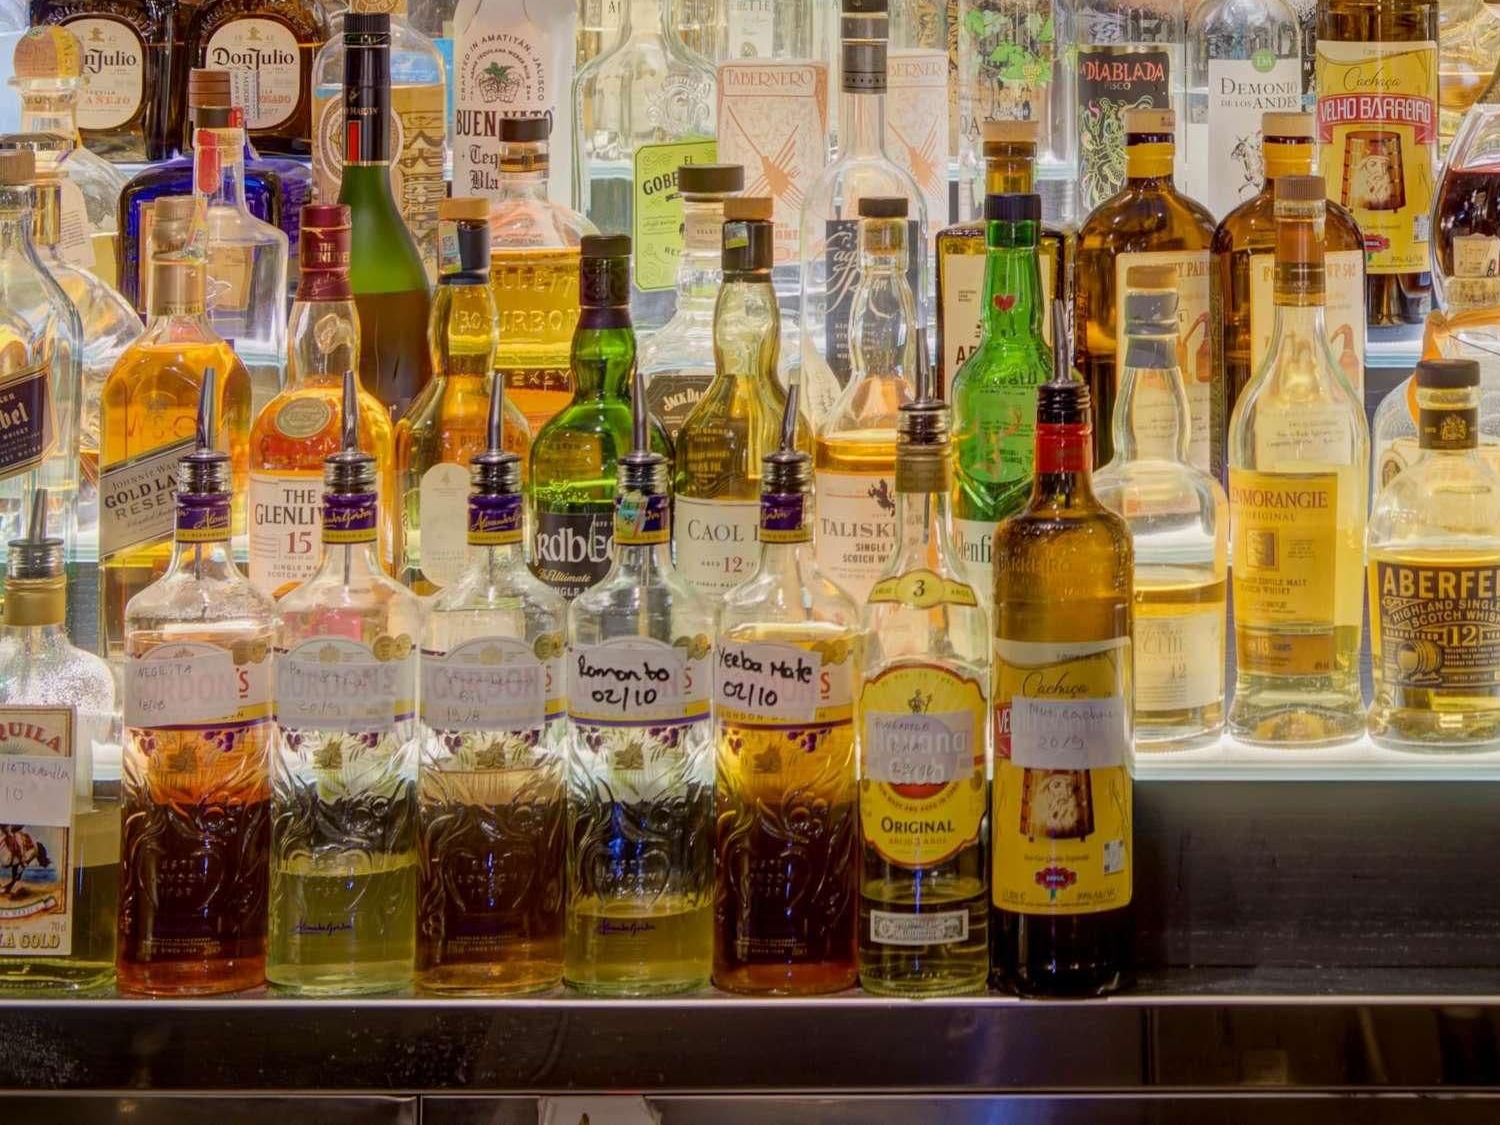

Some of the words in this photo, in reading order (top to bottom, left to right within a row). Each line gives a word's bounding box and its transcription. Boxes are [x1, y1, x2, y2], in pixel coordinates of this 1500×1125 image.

[470, 42, 479, 54] IN
[533, 57, 544, 101] JALISCO
[726, 68, 814, 86] TABERNERO
[1104, 82, 1132, 90] PISCO
[1220, 78, 1298, 95] DEMONIO
[1252, 96, 1297, 109] ANDES
[1320, 98, 1357, 122] VELHO
[1360, 97, 1431, 123] BARREIRO
[456, 110, 496, 136] BUEN
[469, 144, 498, 169] Teq
[470, 169, 498, 194] Bla
[642, 170, 679, 196] GOBE
[664, 391, 686, 411] JACK
[0, 402, 29, 429] bel
[105, 484, 151, 509] GOLD
[155, 475, 177, 491] LA
[283, 489, 316, 503] THE
[114, 491, 176, 520] RESE
[255, 504, 323, 525] GLENLI
[687, 519, 745, 542] CAOL
[820, 518, 896, 537] TALISK
[288, 531, 312, 554] 15
[855, 542, 887, 553] SINGLE
[723, 556, 743, 572] 12
[842, 553, 875, 564] SCOTCH
[913, 580, 925, 597] 3
[1392, 601, 1454, 622] HIGHLAND
[1412, 611, 1461, 628] SCOTCH
[1450, 626, 1478, 646] 12
[592, 688, 657, 711] 02/10
[723, 680, 778, 706] 02/10
[881, 817, 955, 833] ORIGINAL
[21, 934, 60, 949] GOLD
